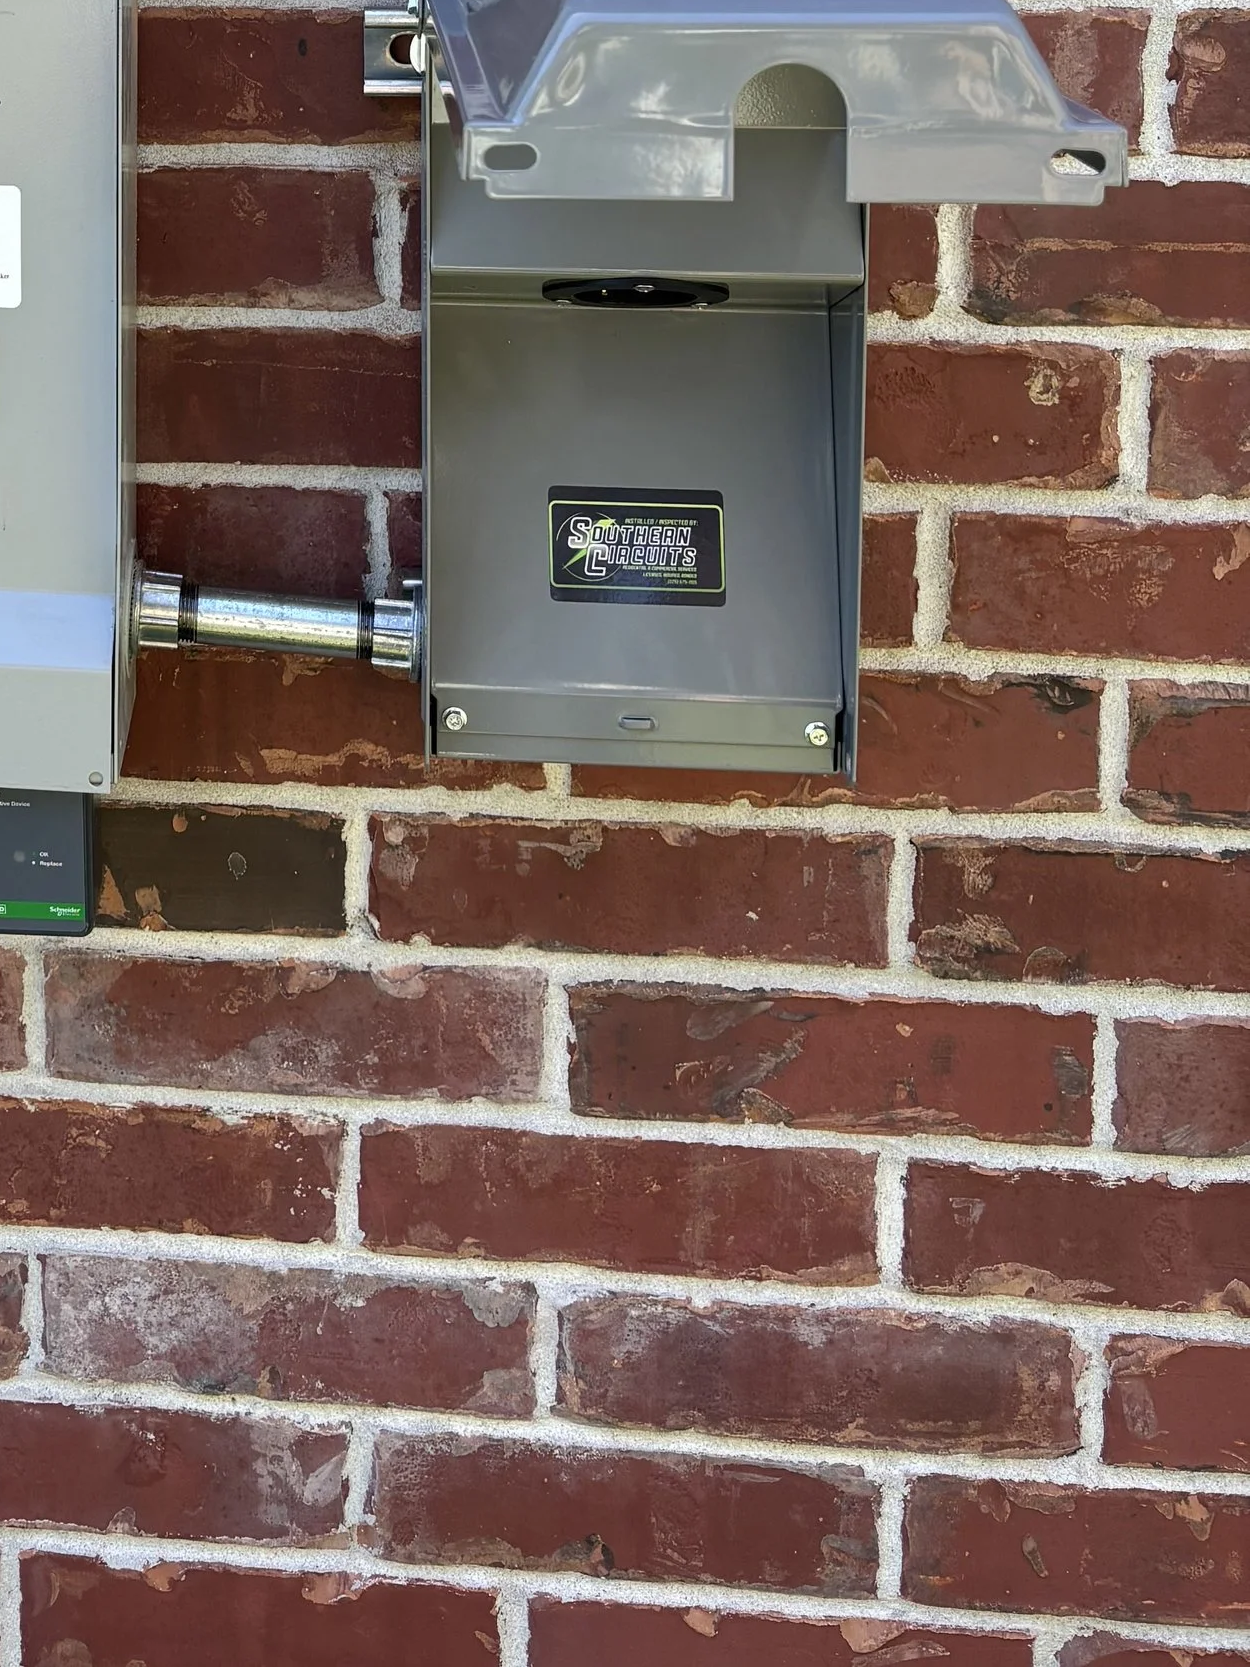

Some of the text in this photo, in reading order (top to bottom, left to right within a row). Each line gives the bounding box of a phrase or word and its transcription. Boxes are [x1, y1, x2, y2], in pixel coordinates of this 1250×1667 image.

[567, 516, 692, 549] SOUTHERN
[584, 543, 697, 576] CIRCUITS
[39, 860, 63, 868] Replace
[49, 905, 81, 914] Schneider
